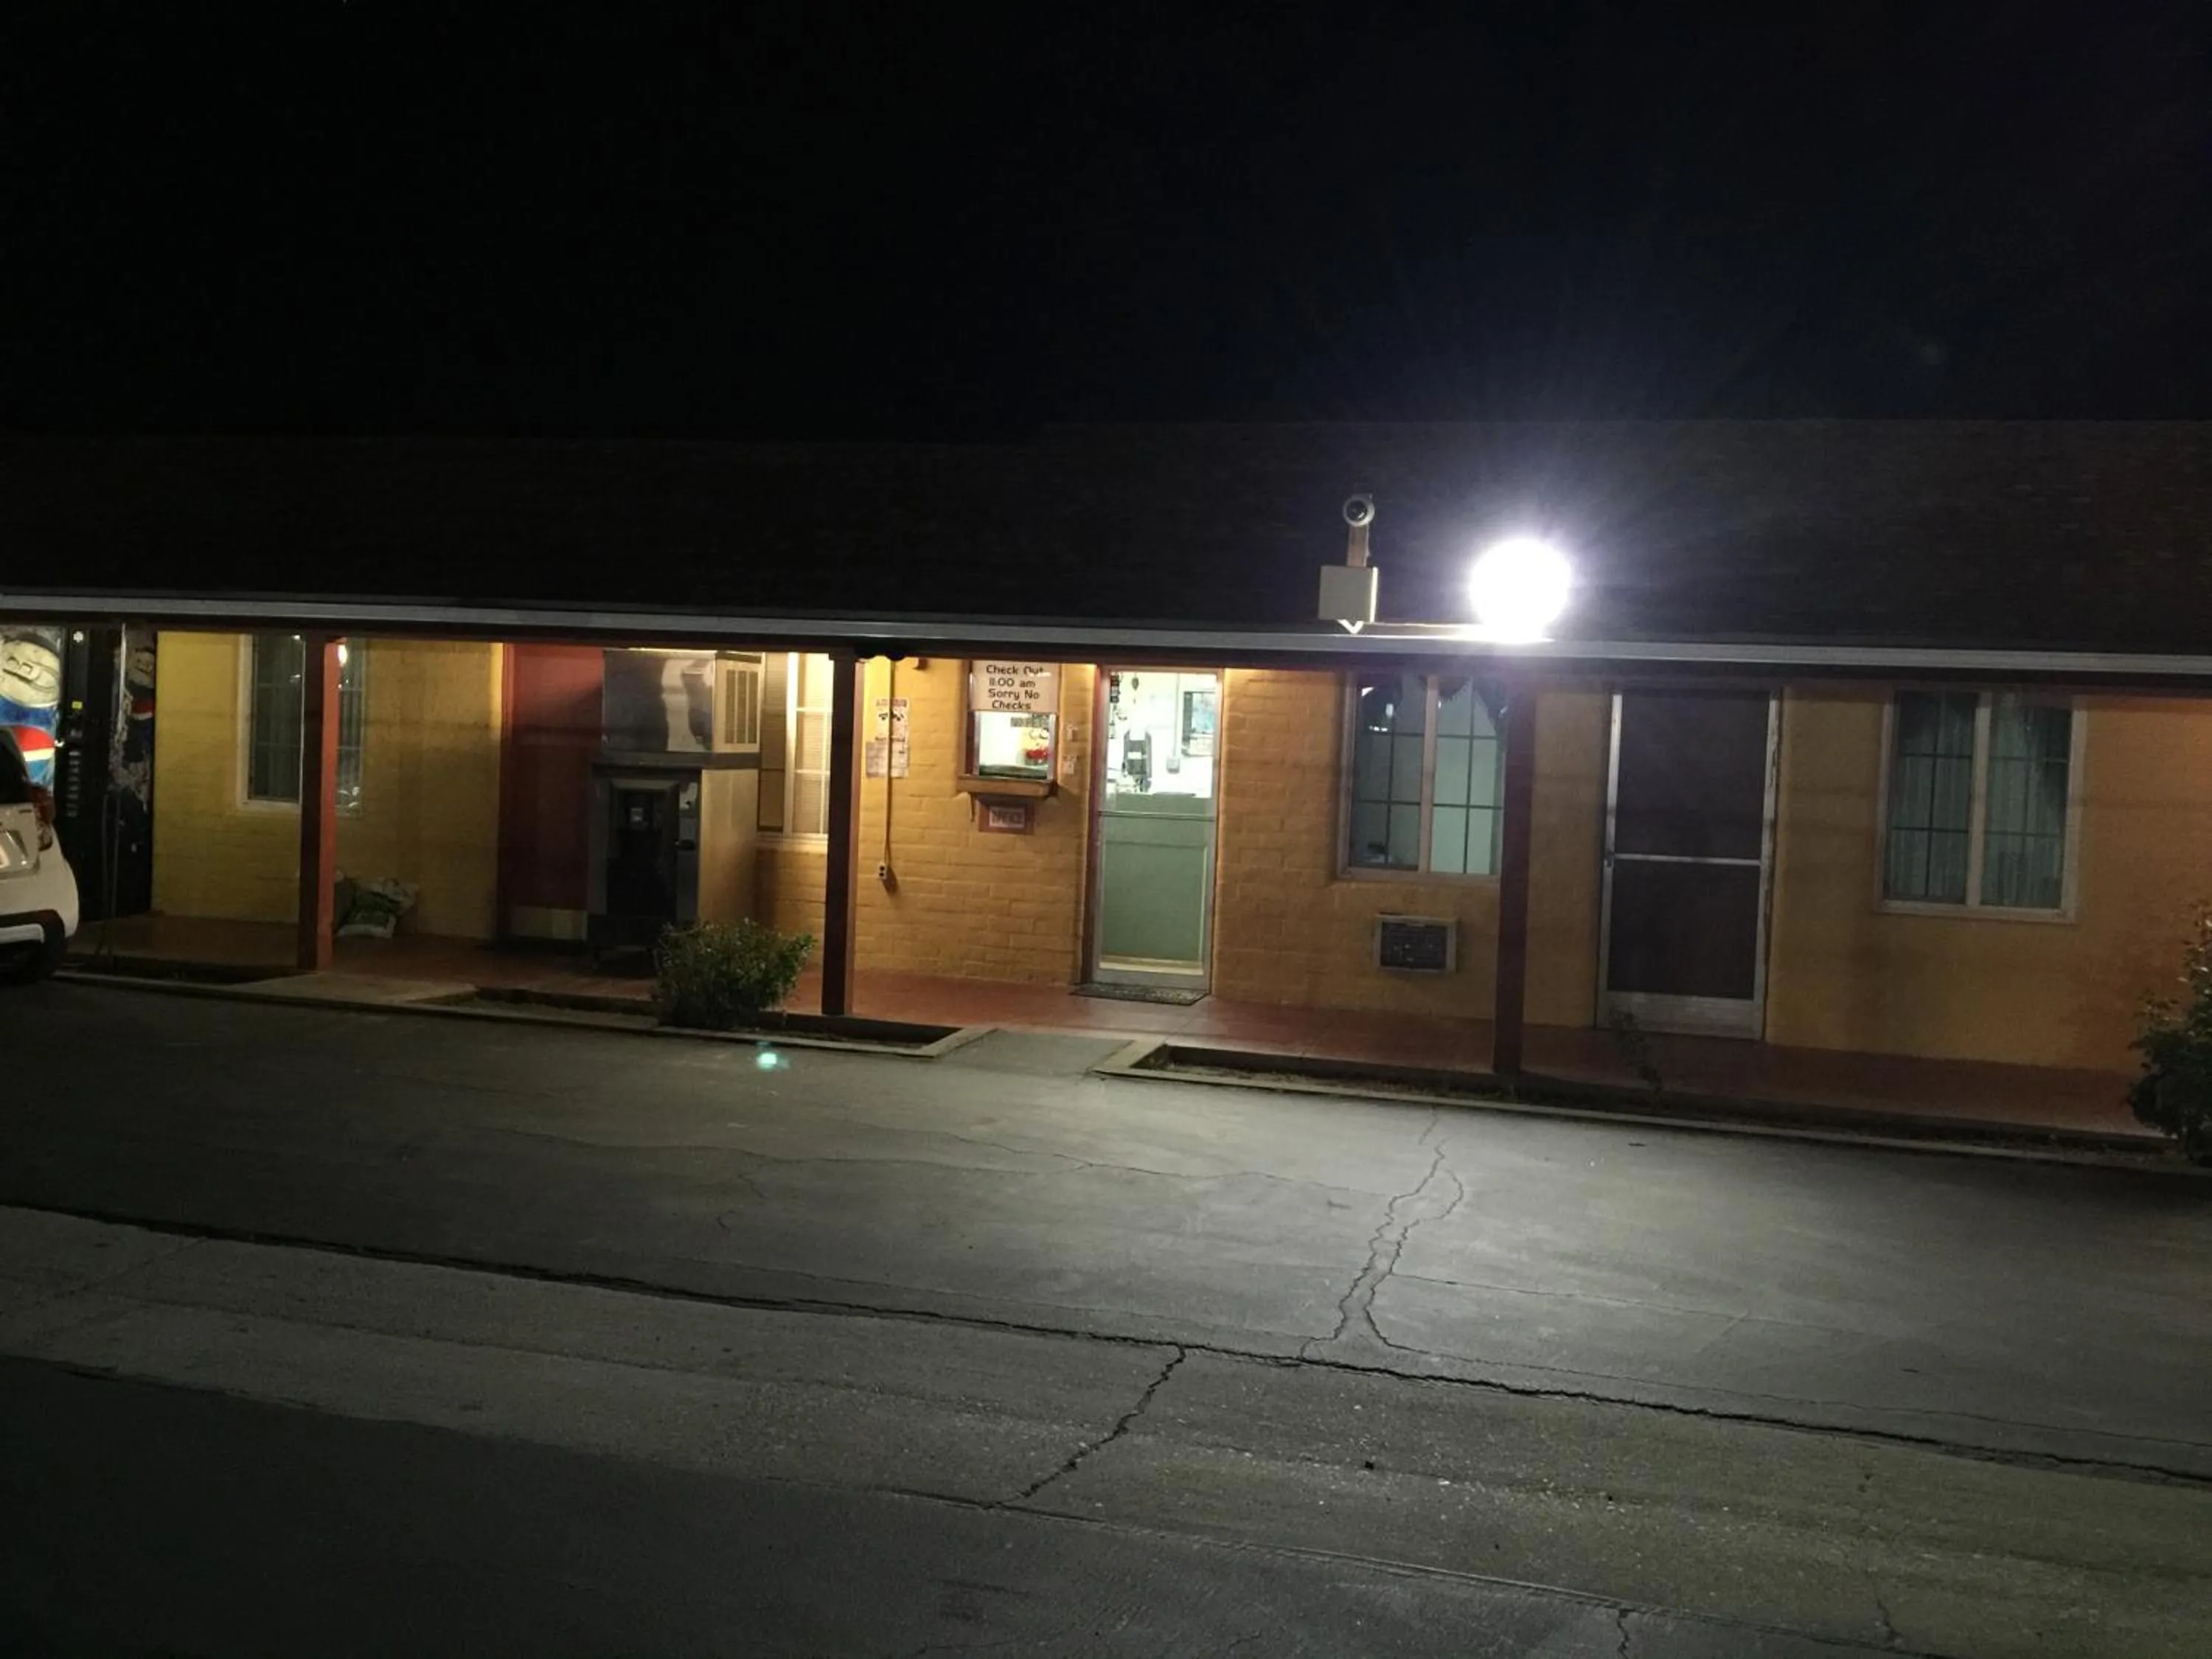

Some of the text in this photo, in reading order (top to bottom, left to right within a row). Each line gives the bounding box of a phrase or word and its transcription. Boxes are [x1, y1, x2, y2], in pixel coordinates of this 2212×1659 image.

[986, 664, 1018, 675] Check
[1020, 680, 1036, 688] am
[988, 689, 1040, 700] Sorry No
[992, 700, 1031, 709] Checks
